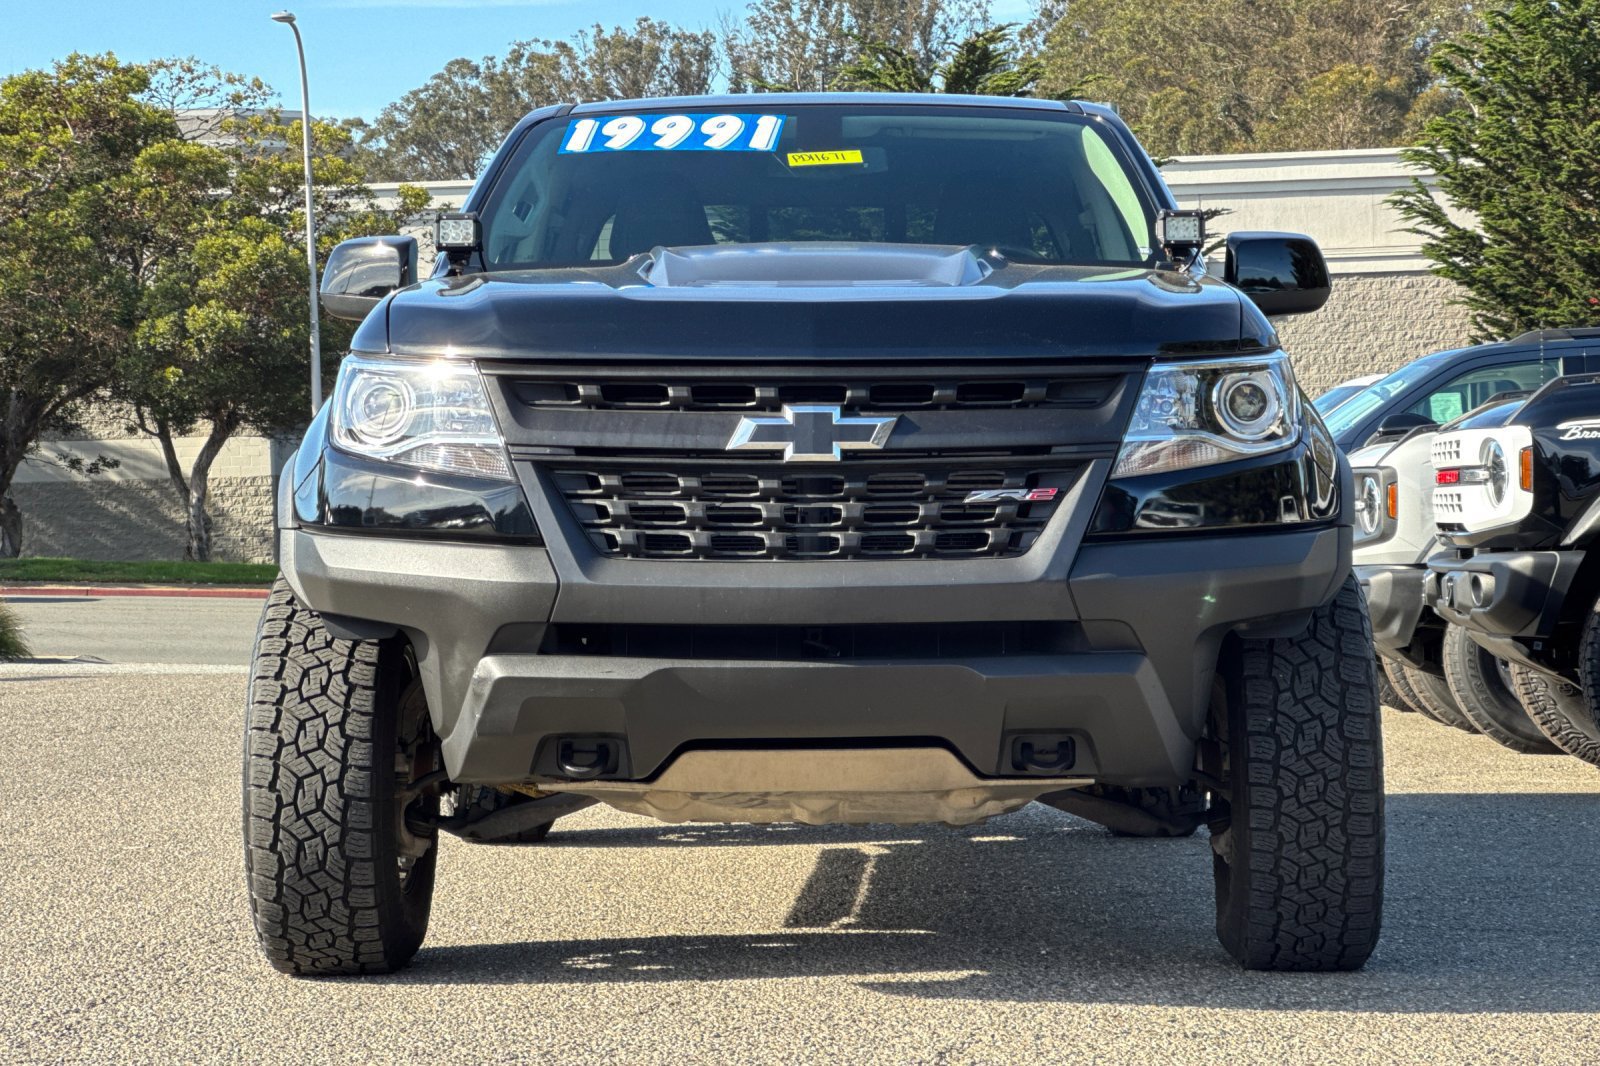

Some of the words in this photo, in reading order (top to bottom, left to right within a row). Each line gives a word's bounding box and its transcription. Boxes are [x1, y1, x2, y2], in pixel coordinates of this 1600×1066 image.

[565, 114, 782, 151] 19991
[1559, 425, 1600, 440] Bro
[962, 487, 1059, 504] ZR2
